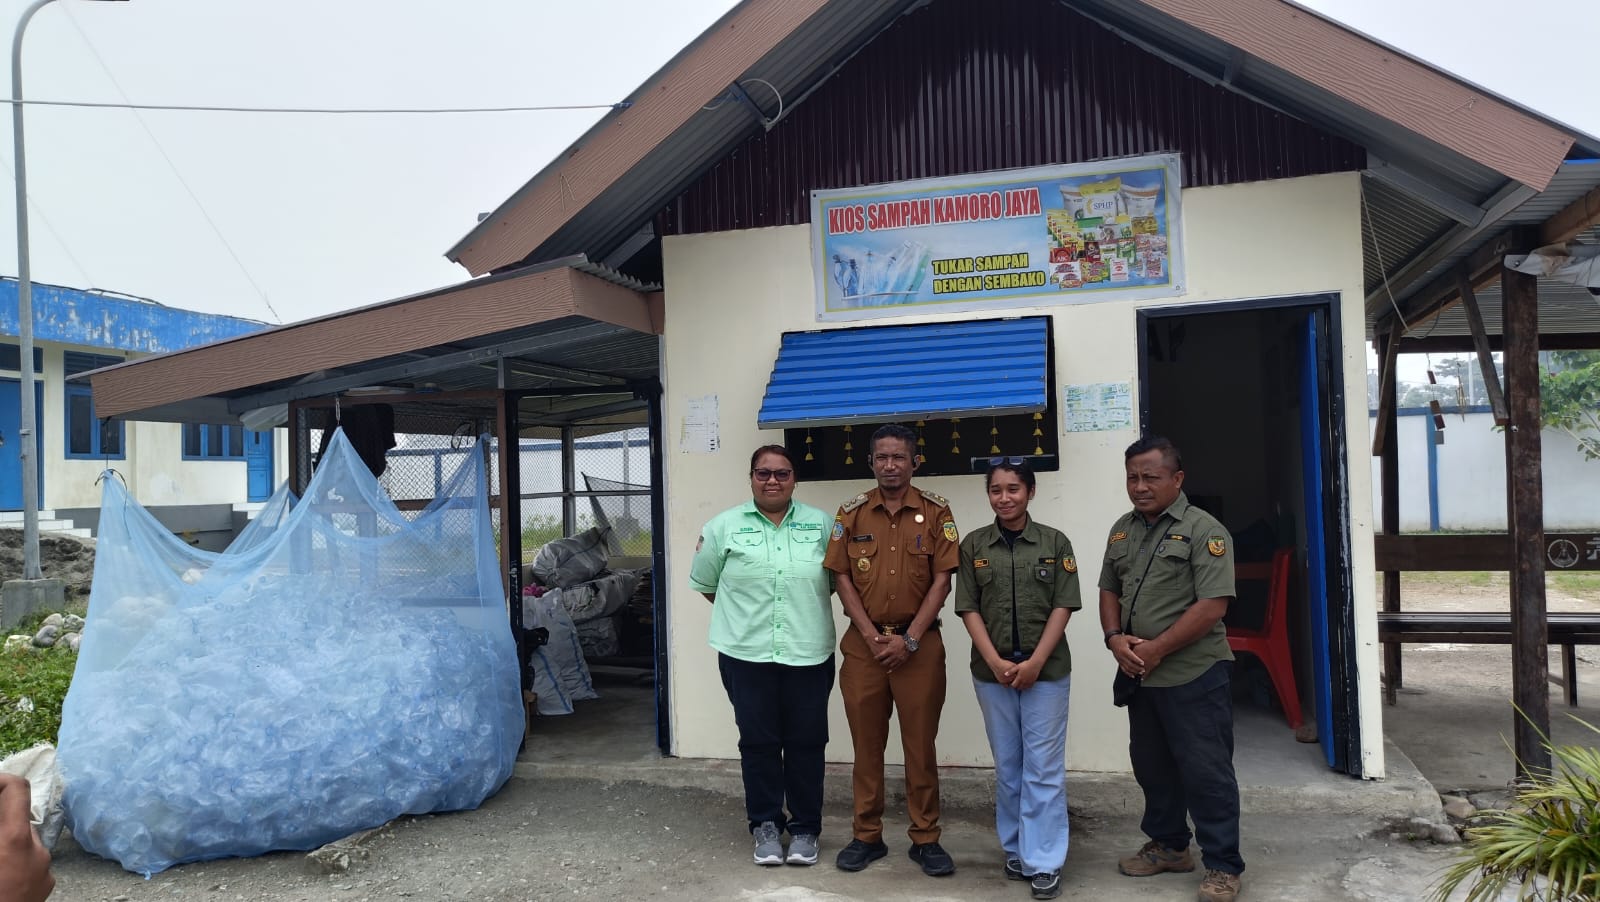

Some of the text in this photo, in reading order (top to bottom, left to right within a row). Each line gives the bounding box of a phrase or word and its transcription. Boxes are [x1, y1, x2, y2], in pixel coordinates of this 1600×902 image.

[829, 188, 1041, 234] KIOS SAMPAH KAMORO JAYA
[1093, 201, 1113, 210] SPHP
[932, 253, 1029, 275] TUKAR SAMPAH
[933, 271, 1046, 294] DENGAN SEMBAKO
